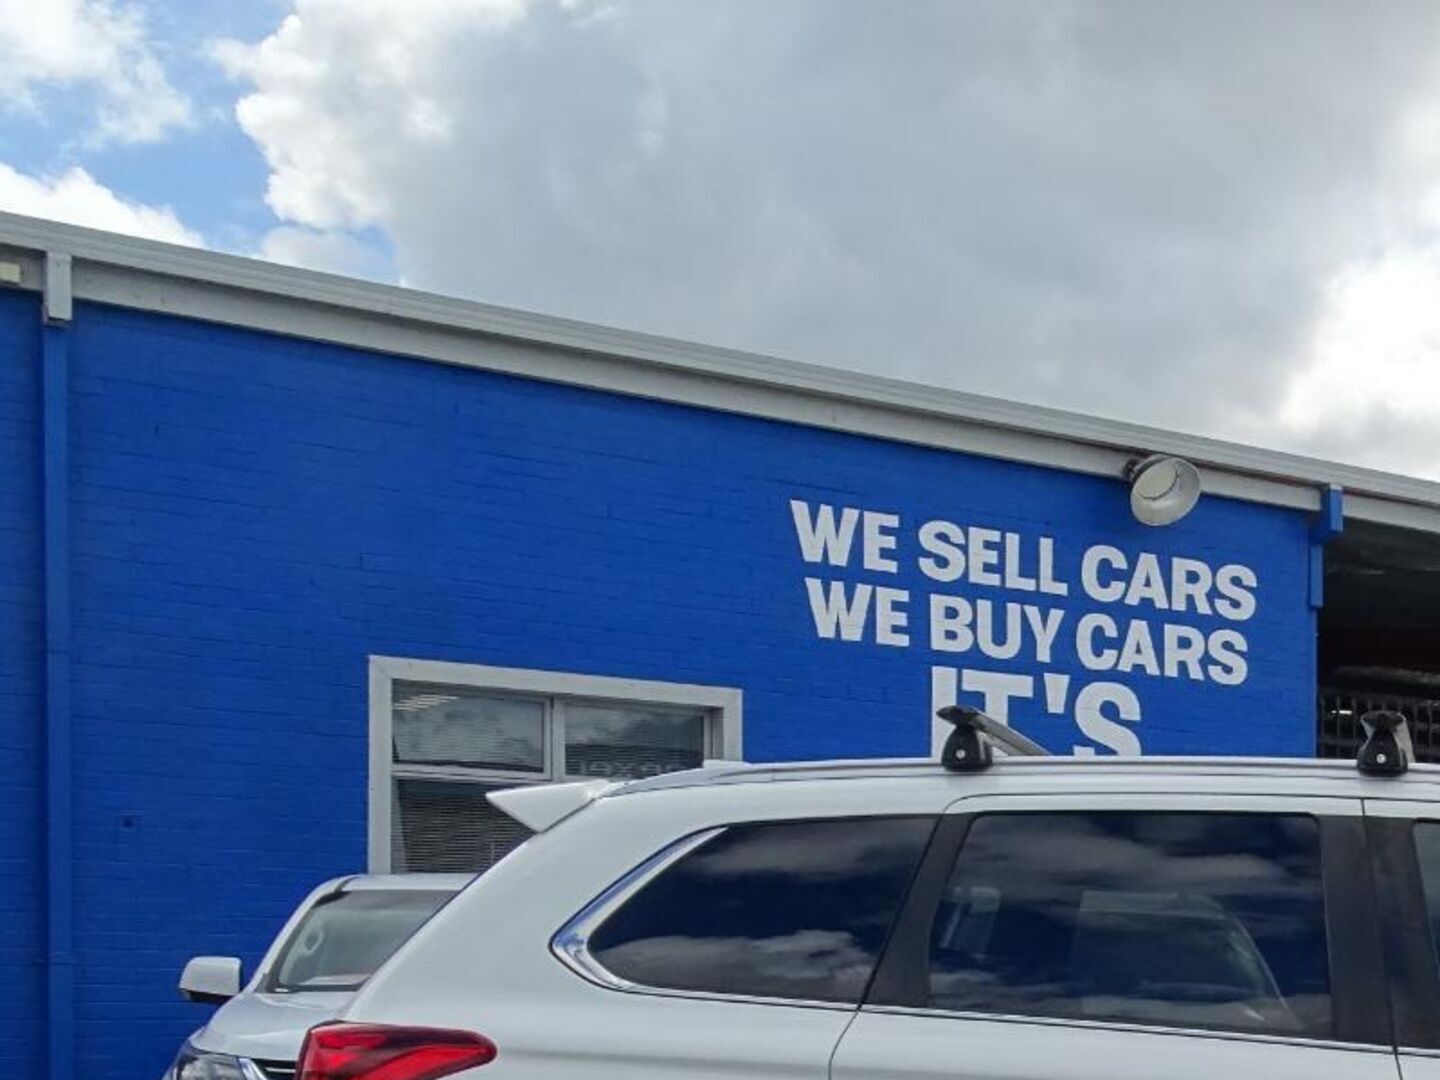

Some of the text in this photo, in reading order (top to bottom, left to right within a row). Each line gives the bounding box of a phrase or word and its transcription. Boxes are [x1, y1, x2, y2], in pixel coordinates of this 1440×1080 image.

[790, 499, 1258, 621] WE SELL CARS
[804, 577, 1248, 685] WE BUY CARS
[930, 666, 1142, 757] IT'S
